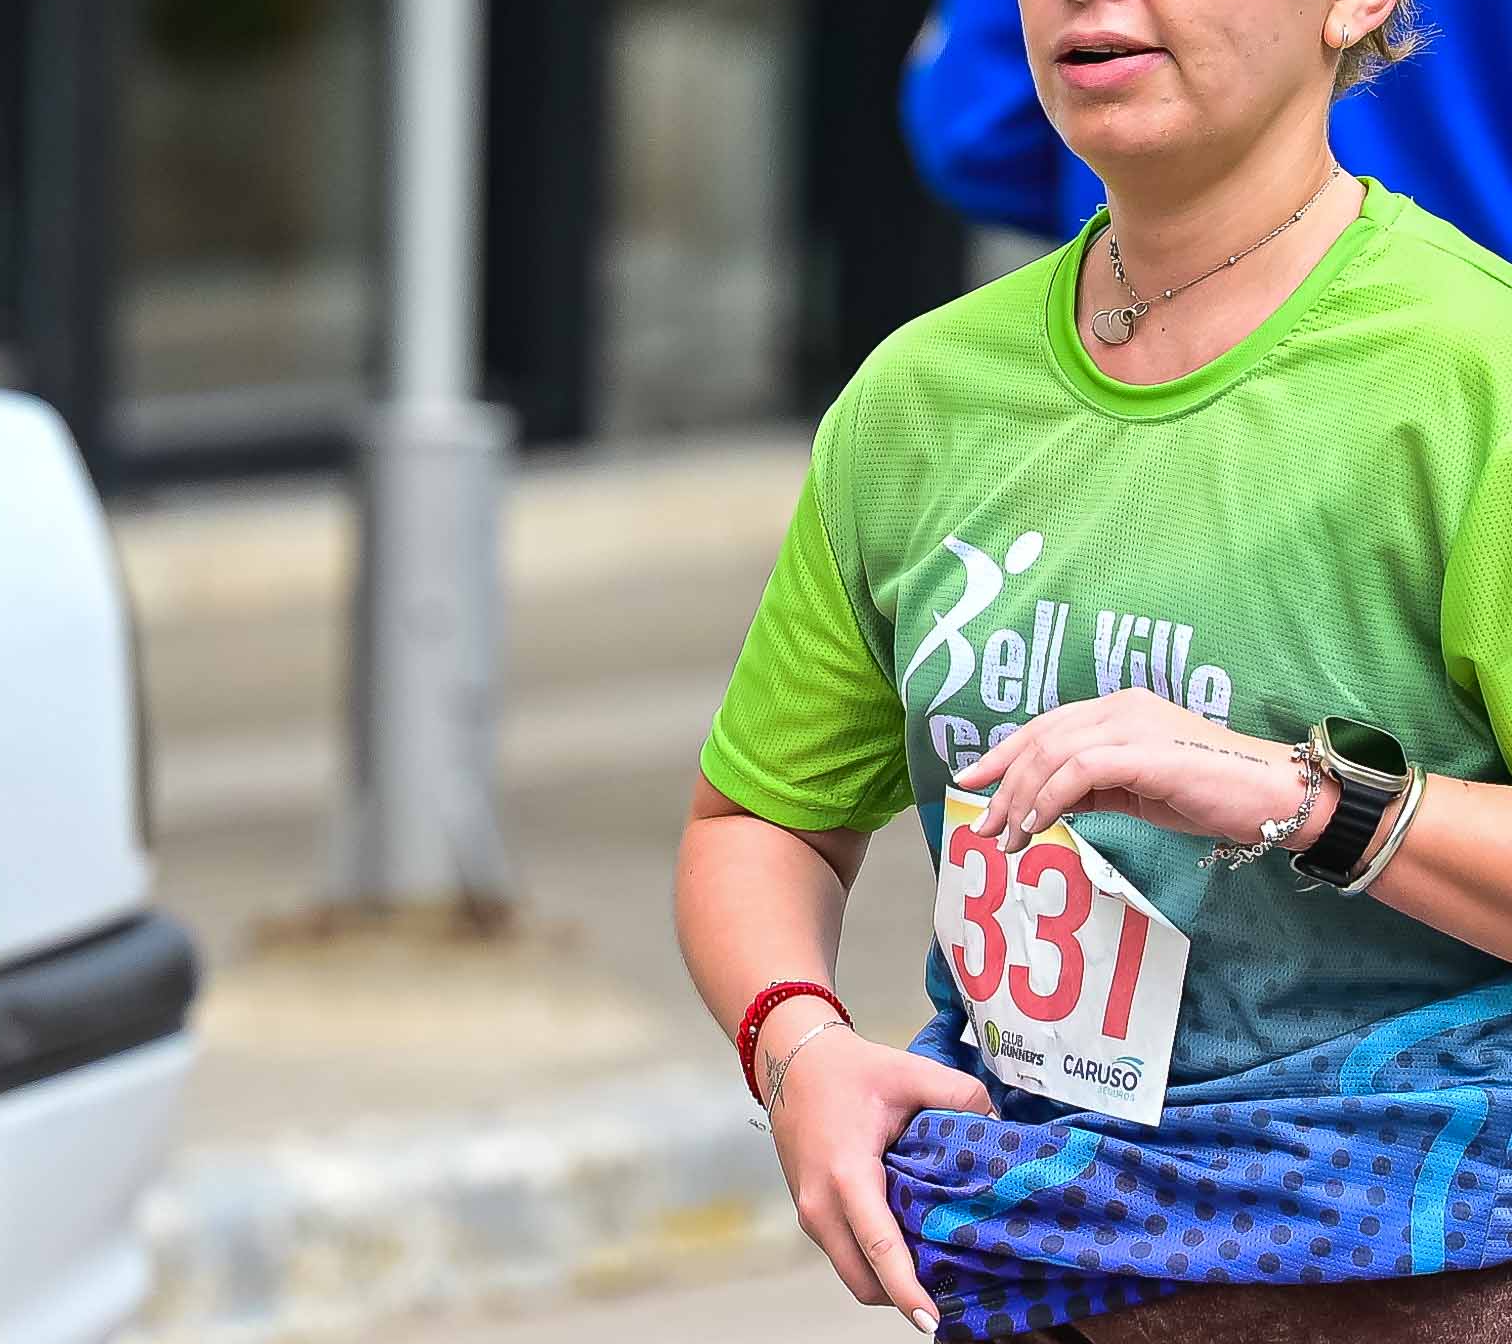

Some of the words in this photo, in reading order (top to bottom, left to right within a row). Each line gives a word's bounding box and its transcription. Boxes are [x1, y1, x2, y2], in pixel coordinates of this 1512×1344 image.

[1093, 609, 1233, 729] Ville
[948, 823, 1150, 1041] 331
[1000, 1029, 1025, 1048] CLUB
[1063, 1054, 1138, 1092] CARUSO
